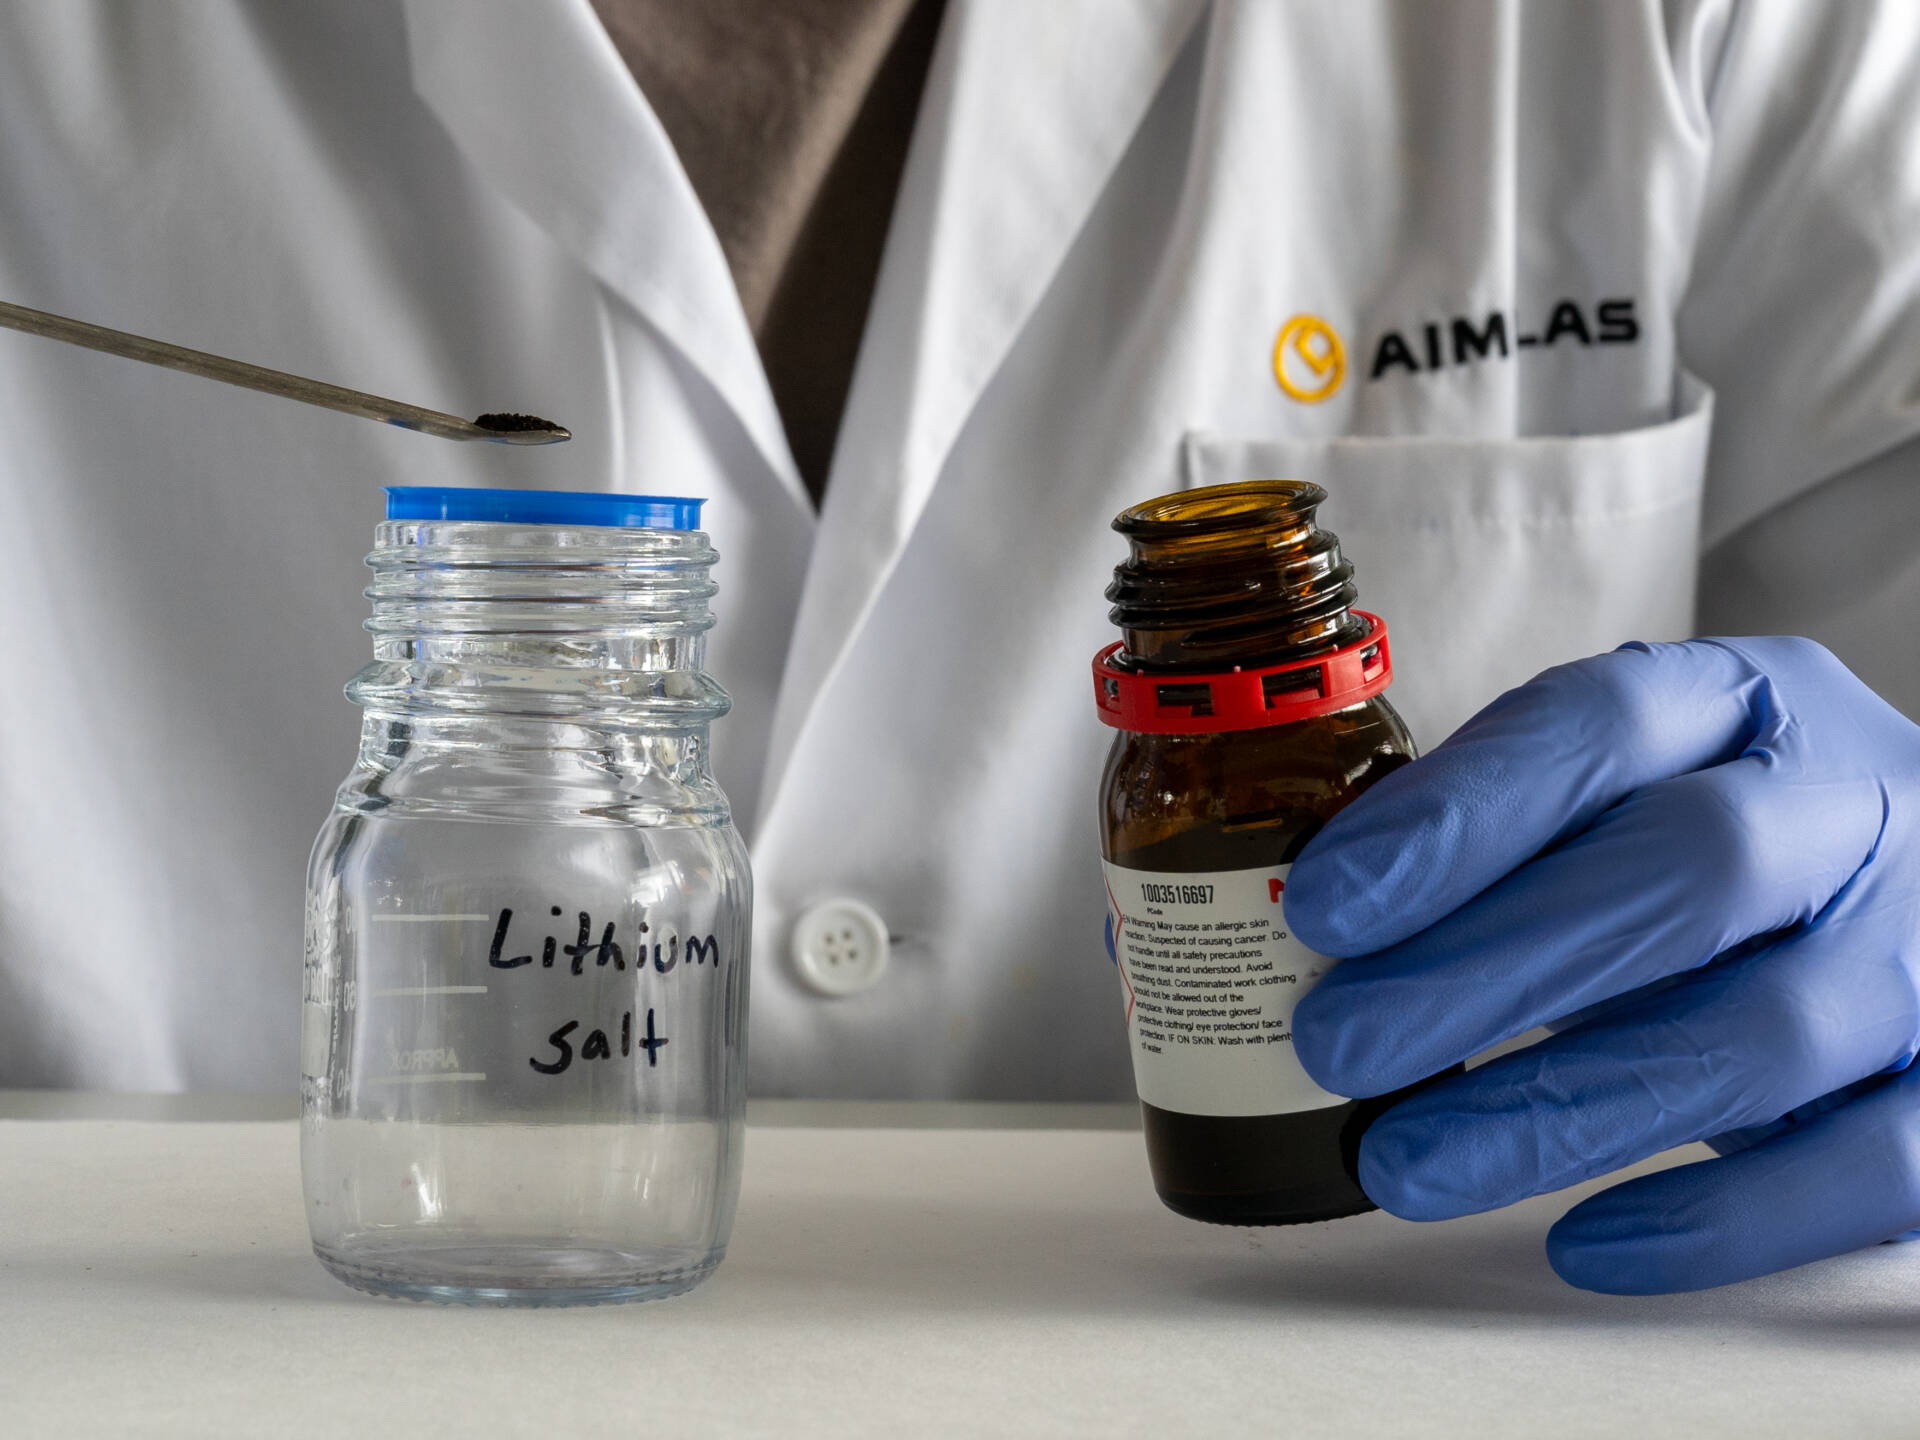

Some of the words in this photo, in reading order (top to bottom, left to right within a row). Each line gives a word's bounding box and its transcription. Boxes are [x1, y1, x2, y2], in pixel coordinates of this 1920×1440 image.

[1141, 883, 1214, 905] 1003516697
[1157, 921, 1173, 932] May
[1215, 922, 1247, 932] allergic
[1249, 920, 1269, 929] skin
[489, 906, 719, 976] Lithium
[1148, 934, 1187, 946] Suspected
[1188, 937, 1197, 945] of
[1198, 938, 1232, 947] causing
[1272, 931, 1287, 941] Do
[1136, 945, 1154, 957] handle
[1172, 950, 1181, 959] all
[1183, 950, 1207, 961] safety
[1209, 950, 1263, 961] precautions
[1142, 961, 1157, 970] been
[1158, 963, 1174, 973] read
[1176, 964, 1190, 974] and
[1246, 962, 1273, 972] Avoid
[1174, 979, 1232, 989] Contaminated
[1234, 978, 1257, 987] work
[1259, 974, 1297, 986] clothing
[1151, 990, 1161, 999] not
[1162, 991, 1171, 999] be
[1172, 993, 1202, 1002] allowed
[1203, 994, 1218, 1002] out
[1219, 993, 1228, 1002] of
[1230, 994, 1244, 1002] the
[1164, 1005, 1185, 1016] Wear
[1186, 1009, 1227, 1018] protective
[1196, 1024, 1211, 1033] eye
[1262, 1020, 1283, 1028] face
[1168, 1034, 1175, 1042] IF
[1177, 1035, 1190, 1044] ON
[1218, 1036, 1244, 1045] Wash
[1245, 1035, 1264, 1044] with
